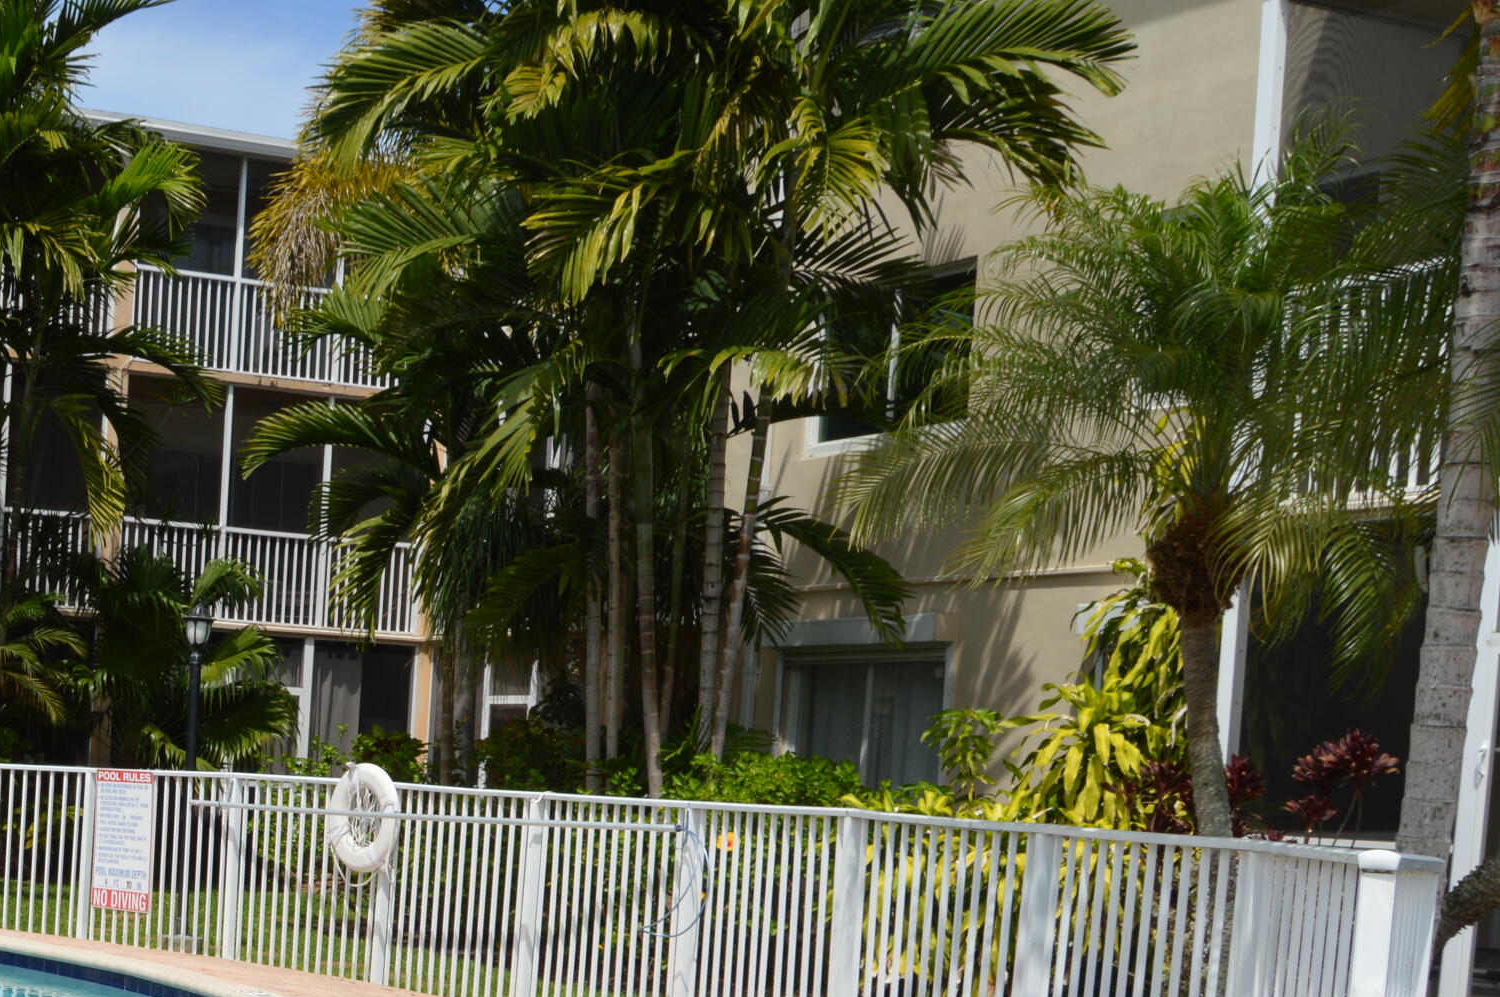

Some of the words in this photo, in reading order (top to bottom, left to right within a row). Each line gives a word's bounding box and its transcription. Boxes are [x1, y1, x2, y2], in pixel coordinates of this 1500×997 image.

[98, 770, 121, 781] POOL
[123, 772, 152, 783] RULES
[108, 868, 131, 879] MAXIMUM
[93, 889, 108, 907] NO
[111, 890, 147, 911] DIVING
